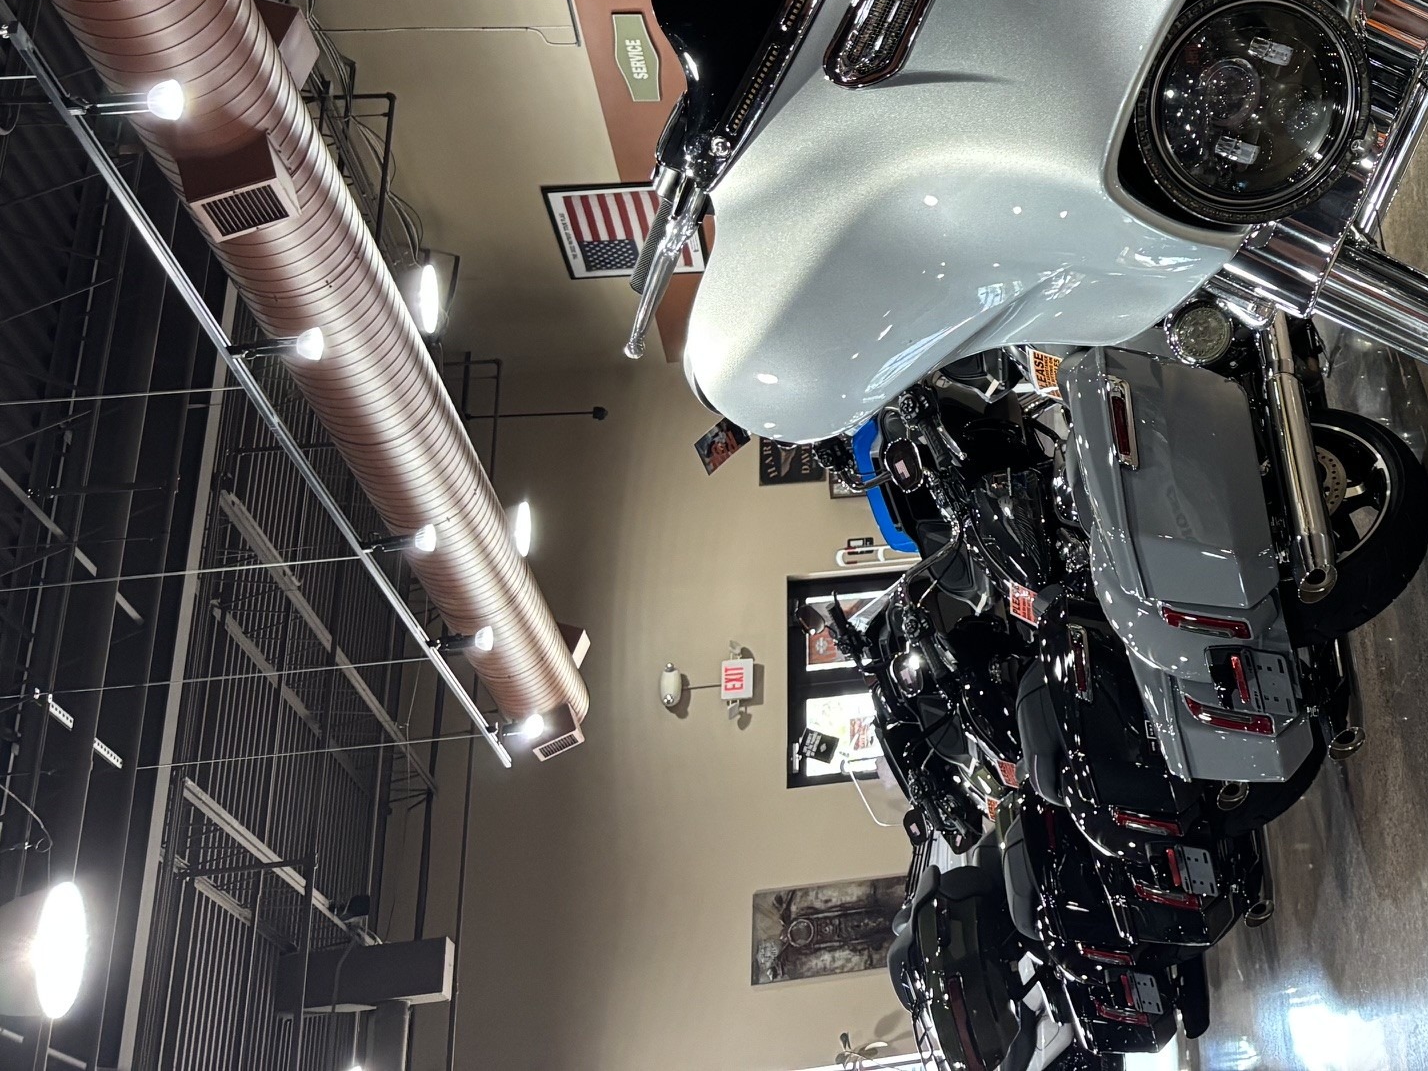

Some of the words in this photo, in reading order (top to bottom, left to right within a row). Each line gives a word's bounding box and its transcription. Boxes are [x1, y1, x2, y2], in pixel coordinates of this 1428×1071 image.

[624, 39, 649, 80] SERVICE
[1033, 351, 1048, 389] LEASE
[724, 666, 744, 692] EXIT
